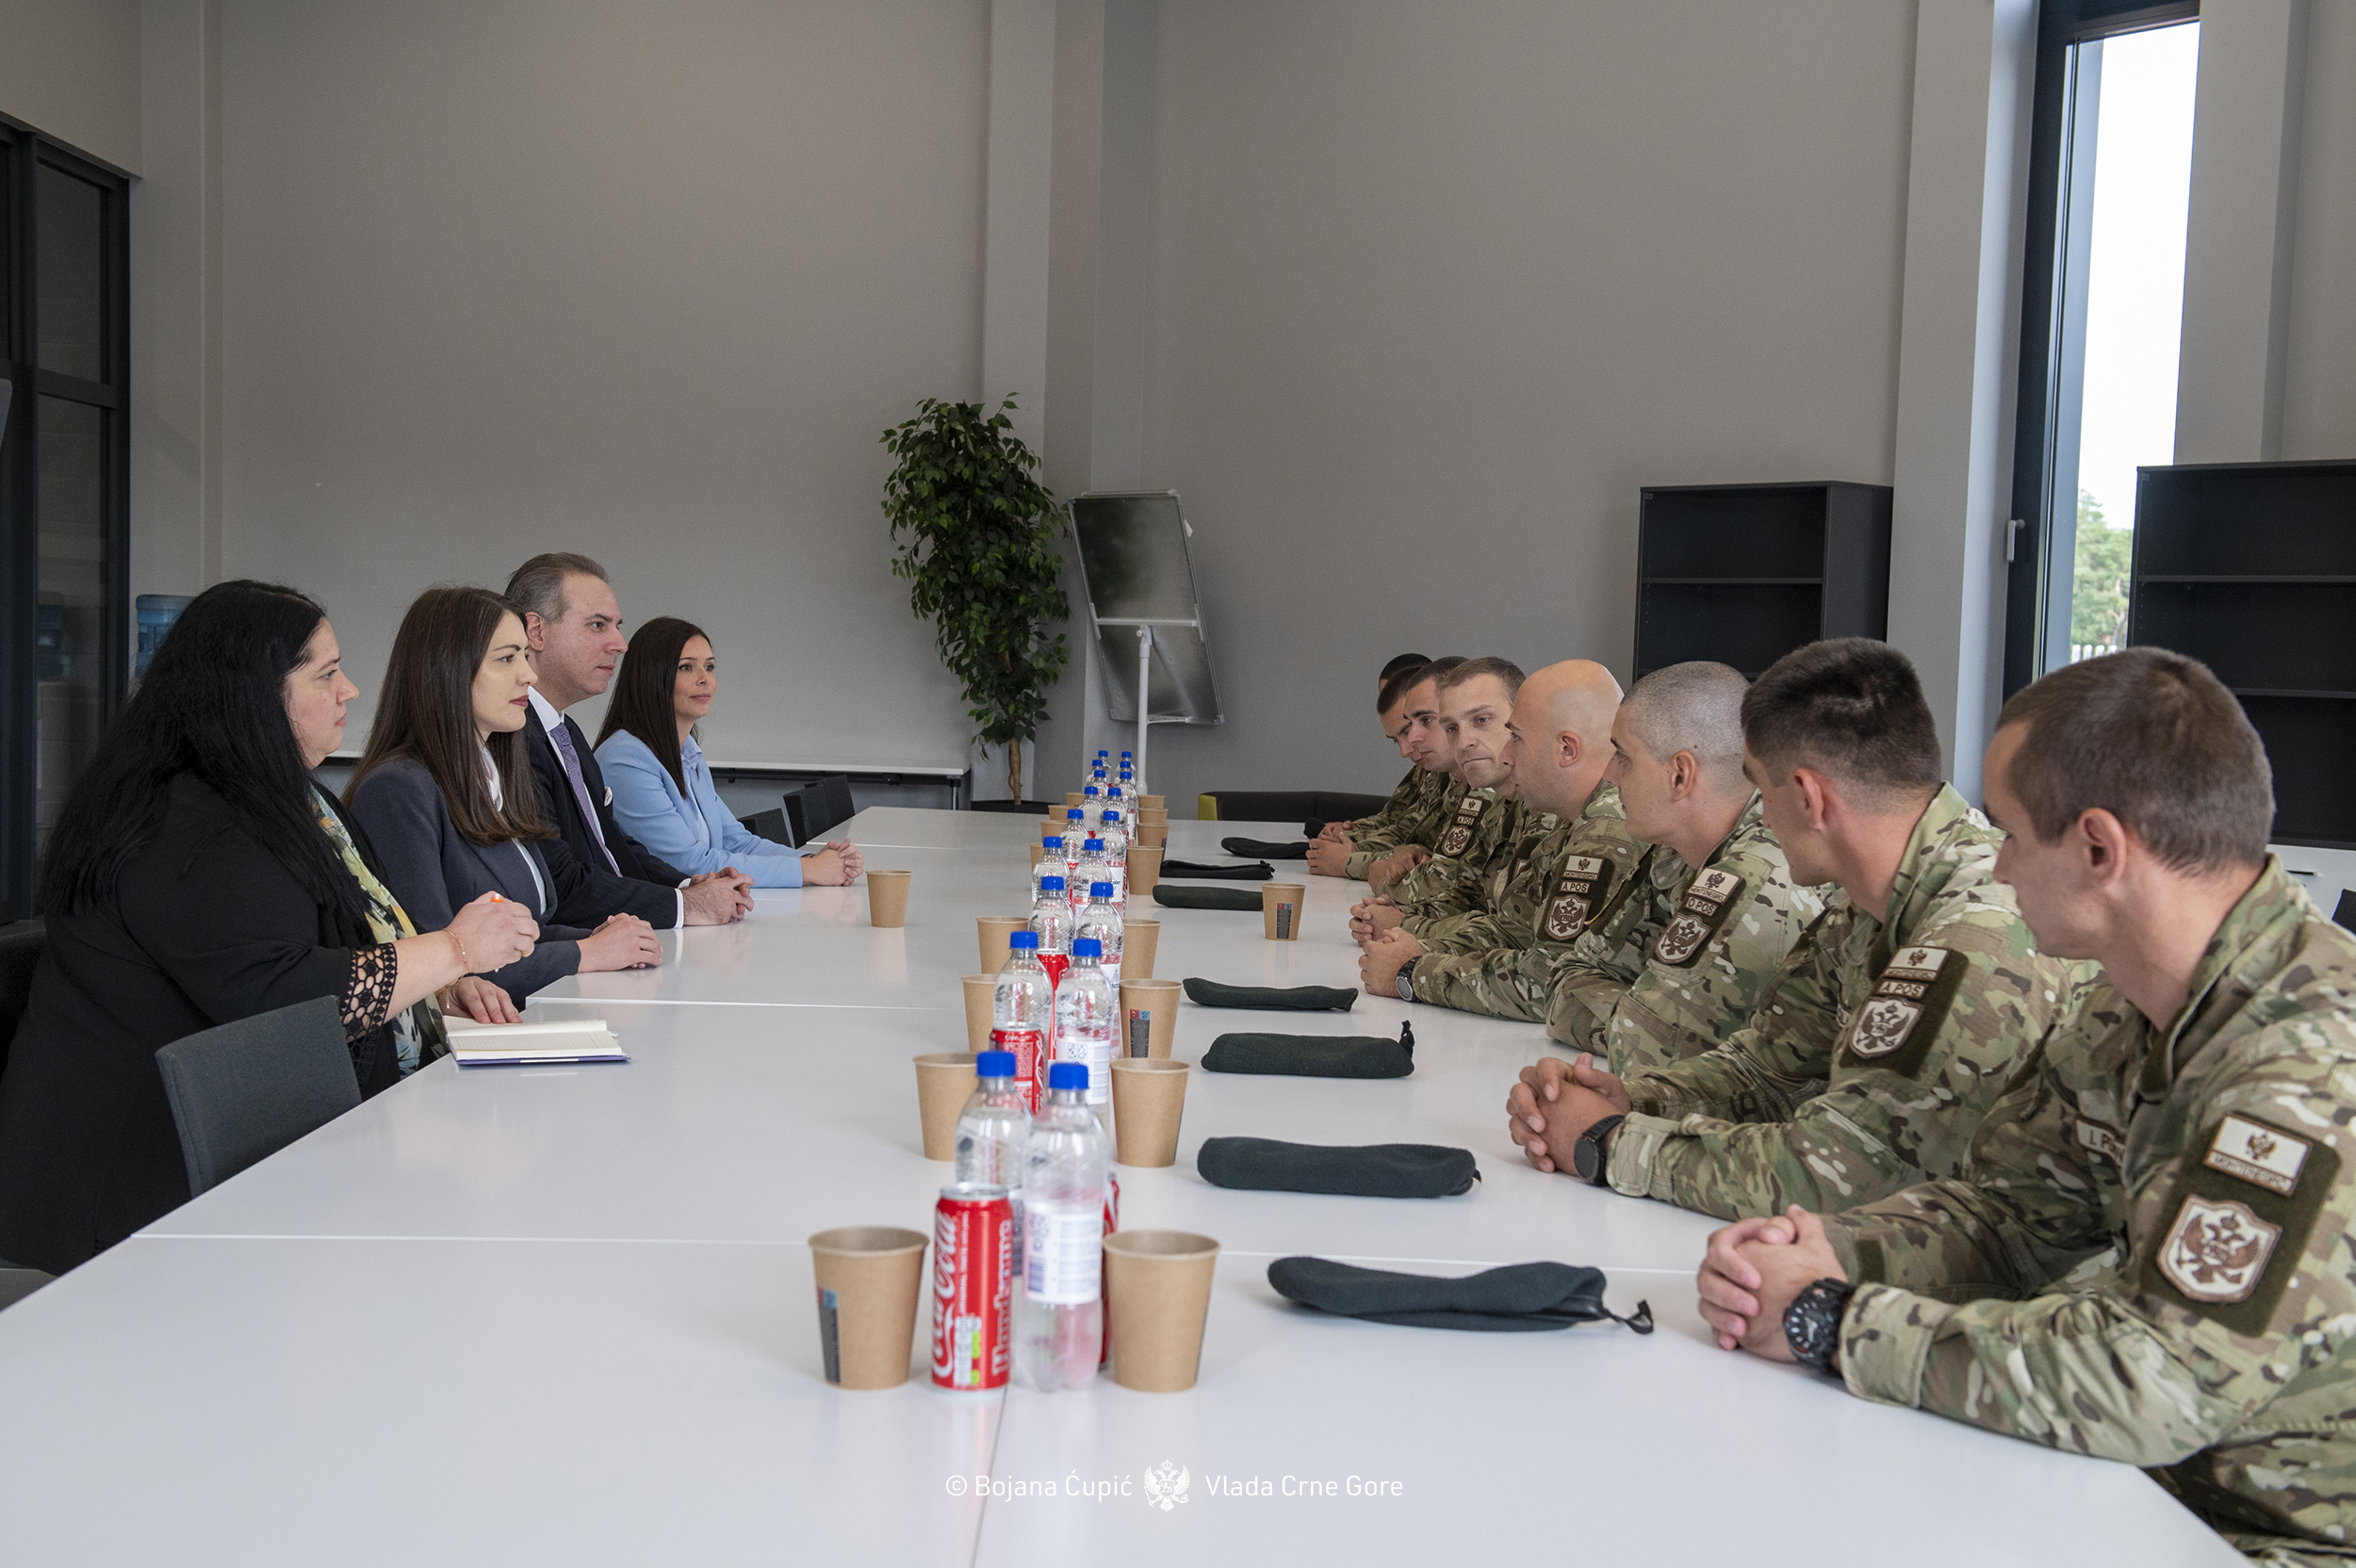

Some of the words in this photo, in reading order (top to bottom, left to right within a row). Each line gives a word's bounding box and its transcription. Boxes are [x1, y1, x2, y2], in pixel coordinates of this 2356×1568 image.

[1562, 882, 1568, 890] A
[1570, 883, 1588, 892] POS
[1690, 887, 1724, 902] MONTENEGRO
[1695, 901, 1714, 915] POS
[1882, 982, 1890, 992] A
[1894, 983, 1922, 996] POS
